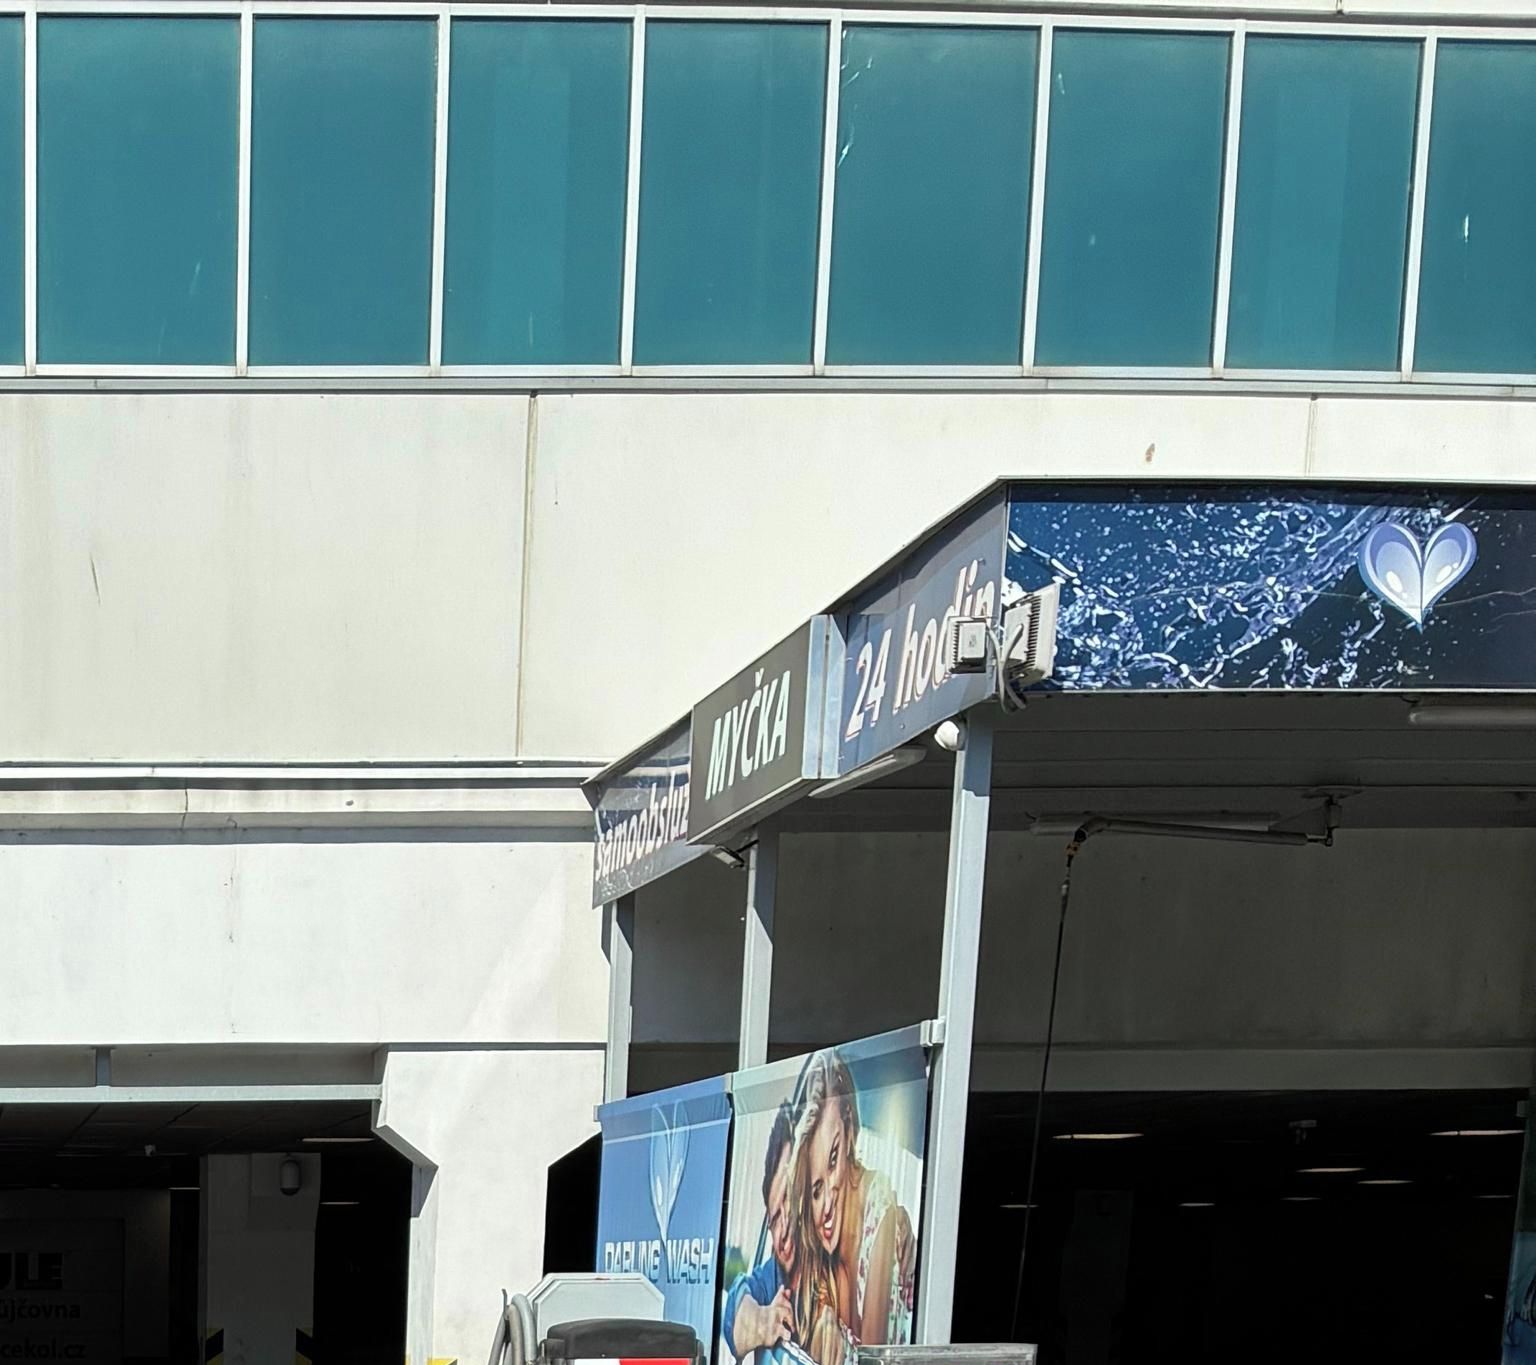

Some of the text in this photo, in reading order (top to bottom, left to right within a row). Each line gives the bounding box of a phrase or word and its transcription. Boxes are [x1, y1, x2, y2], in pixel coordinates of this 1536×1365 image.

[705, 668, 791, 801] MYČKA
[845, 629, 892, 742] 24
[605, 1237, 714, 1284] DARLING WASH
